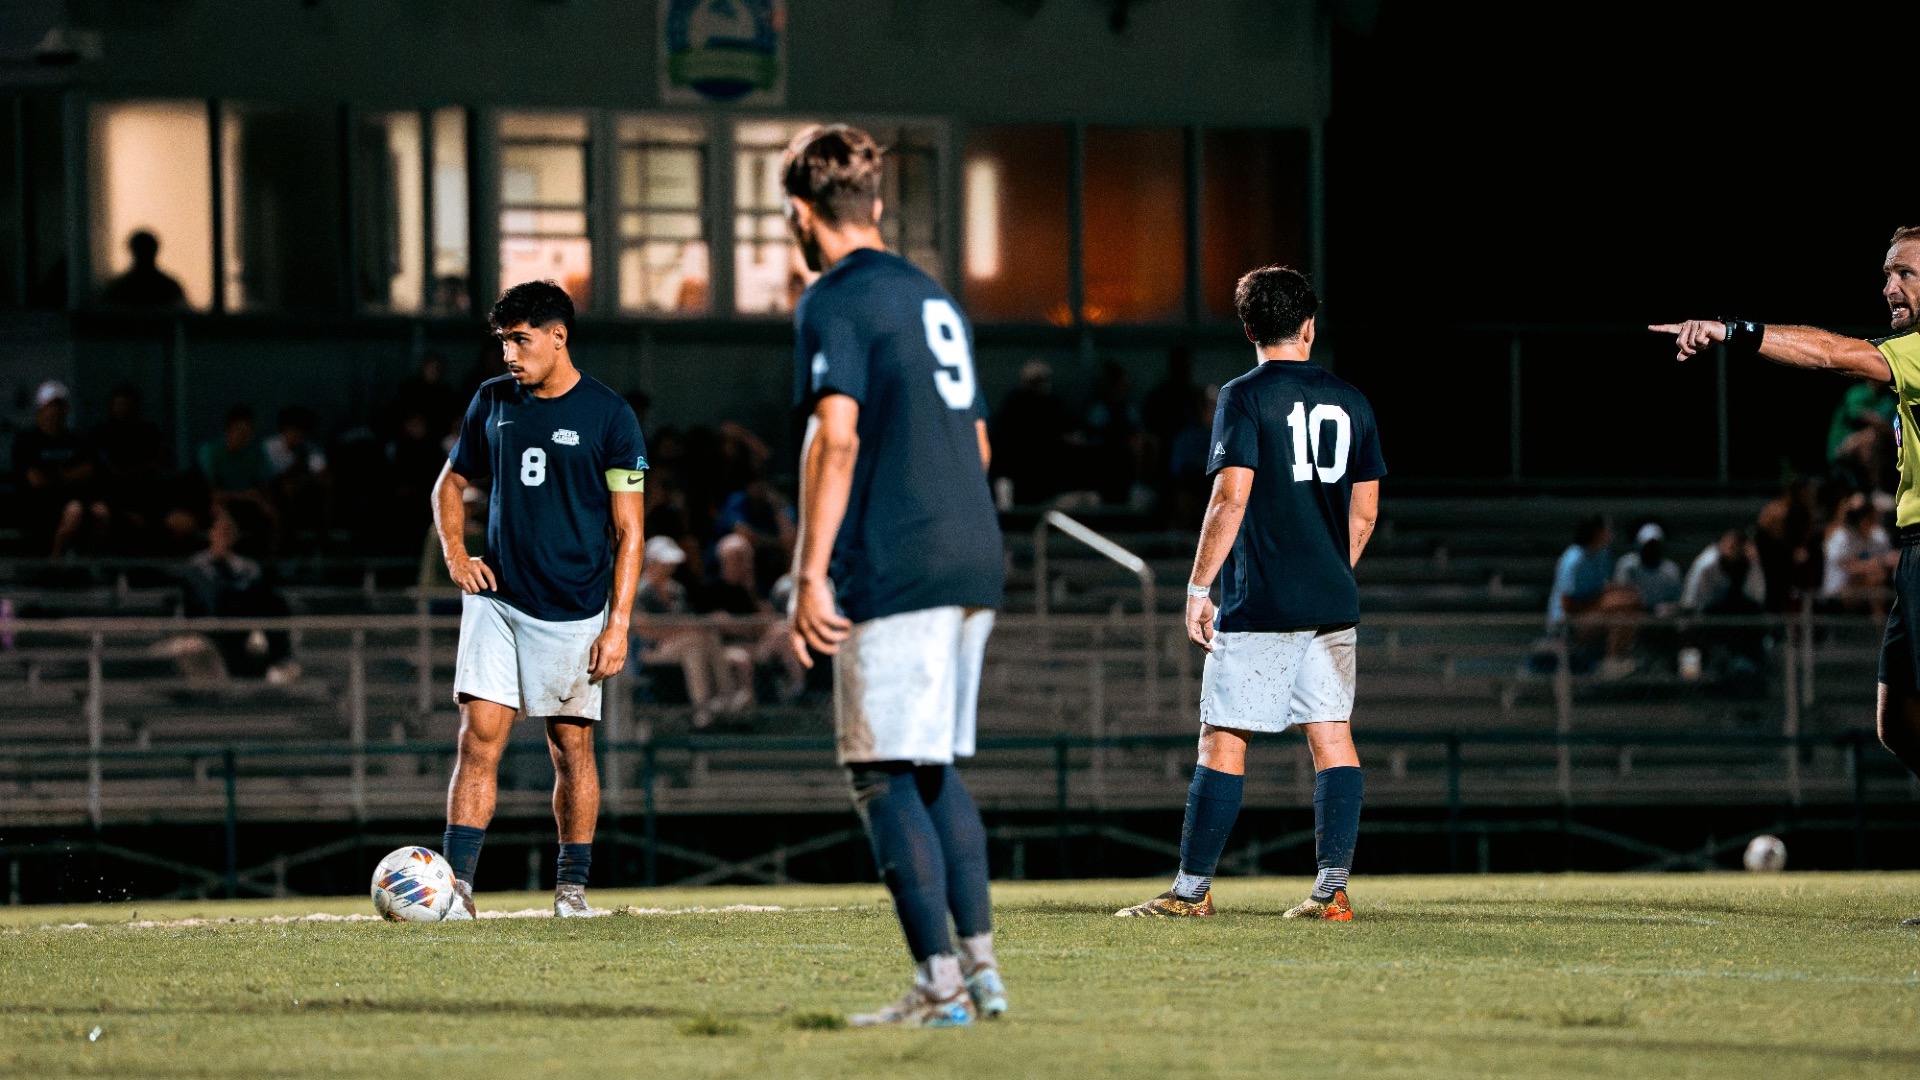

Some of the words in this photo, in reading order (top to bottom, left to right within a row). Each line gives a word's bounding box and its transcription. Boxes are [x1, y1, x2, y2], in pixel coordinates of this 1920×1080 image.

[922, 299, 976, 409] 9
[520, 447, 547, 486] 8
[1287, 402, 1350, 484] 10
